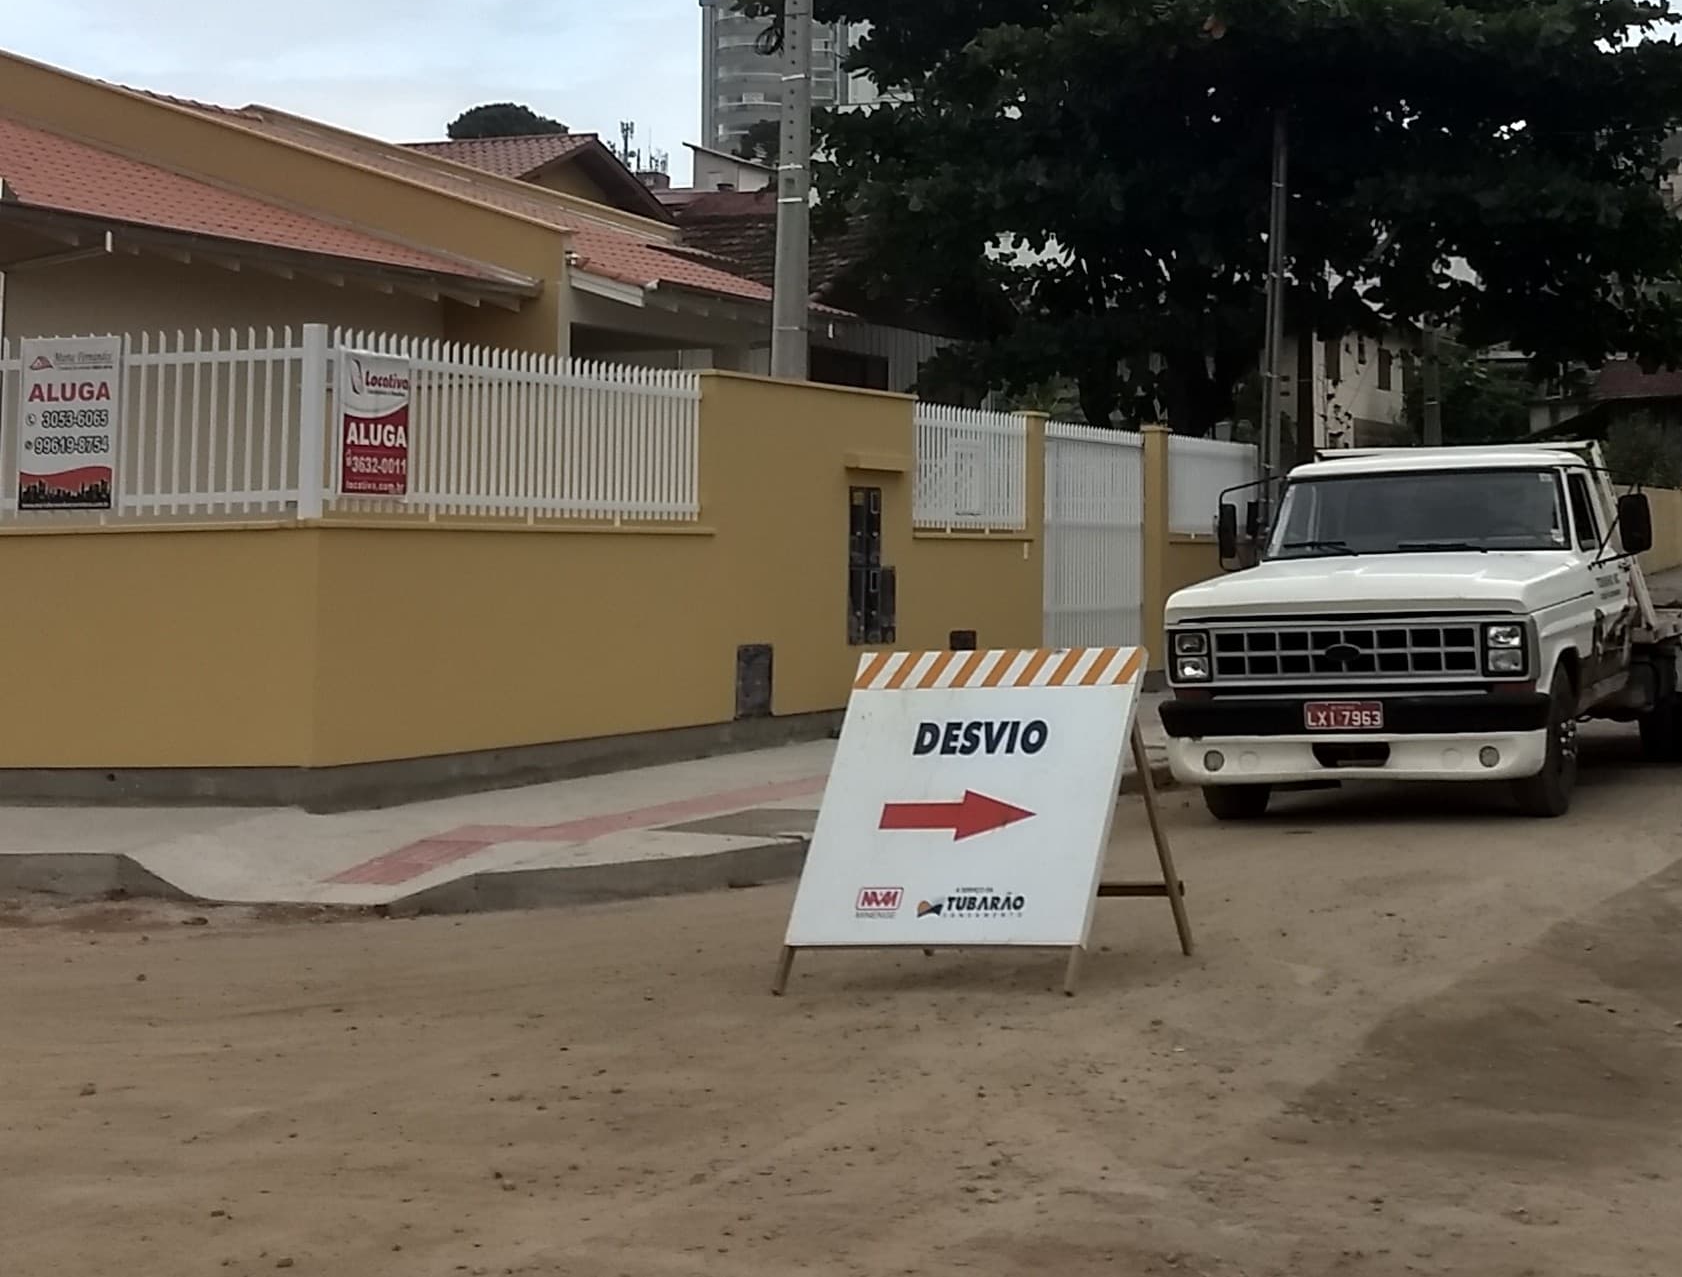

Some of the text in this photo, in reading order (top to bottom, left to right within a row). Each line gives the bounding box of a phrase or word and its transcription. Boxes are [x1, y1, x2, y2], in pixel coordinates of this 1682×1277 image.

[365, 370, 410, 391] Locativa
[28, 381, 110, 402] ALUGA
[41, 409, 109, 428] 3053-6065
[34, 435, 109, 455] 99619-8754
[346, 422, 407, 448] ALUGA
[352, 456, 407, 475] 3632-0011
[1341, 711, 1381, 726] 7963
[912, 720, 1049, 756] DESVIO
[947, 892, 1025, 911] TUBARÃO
